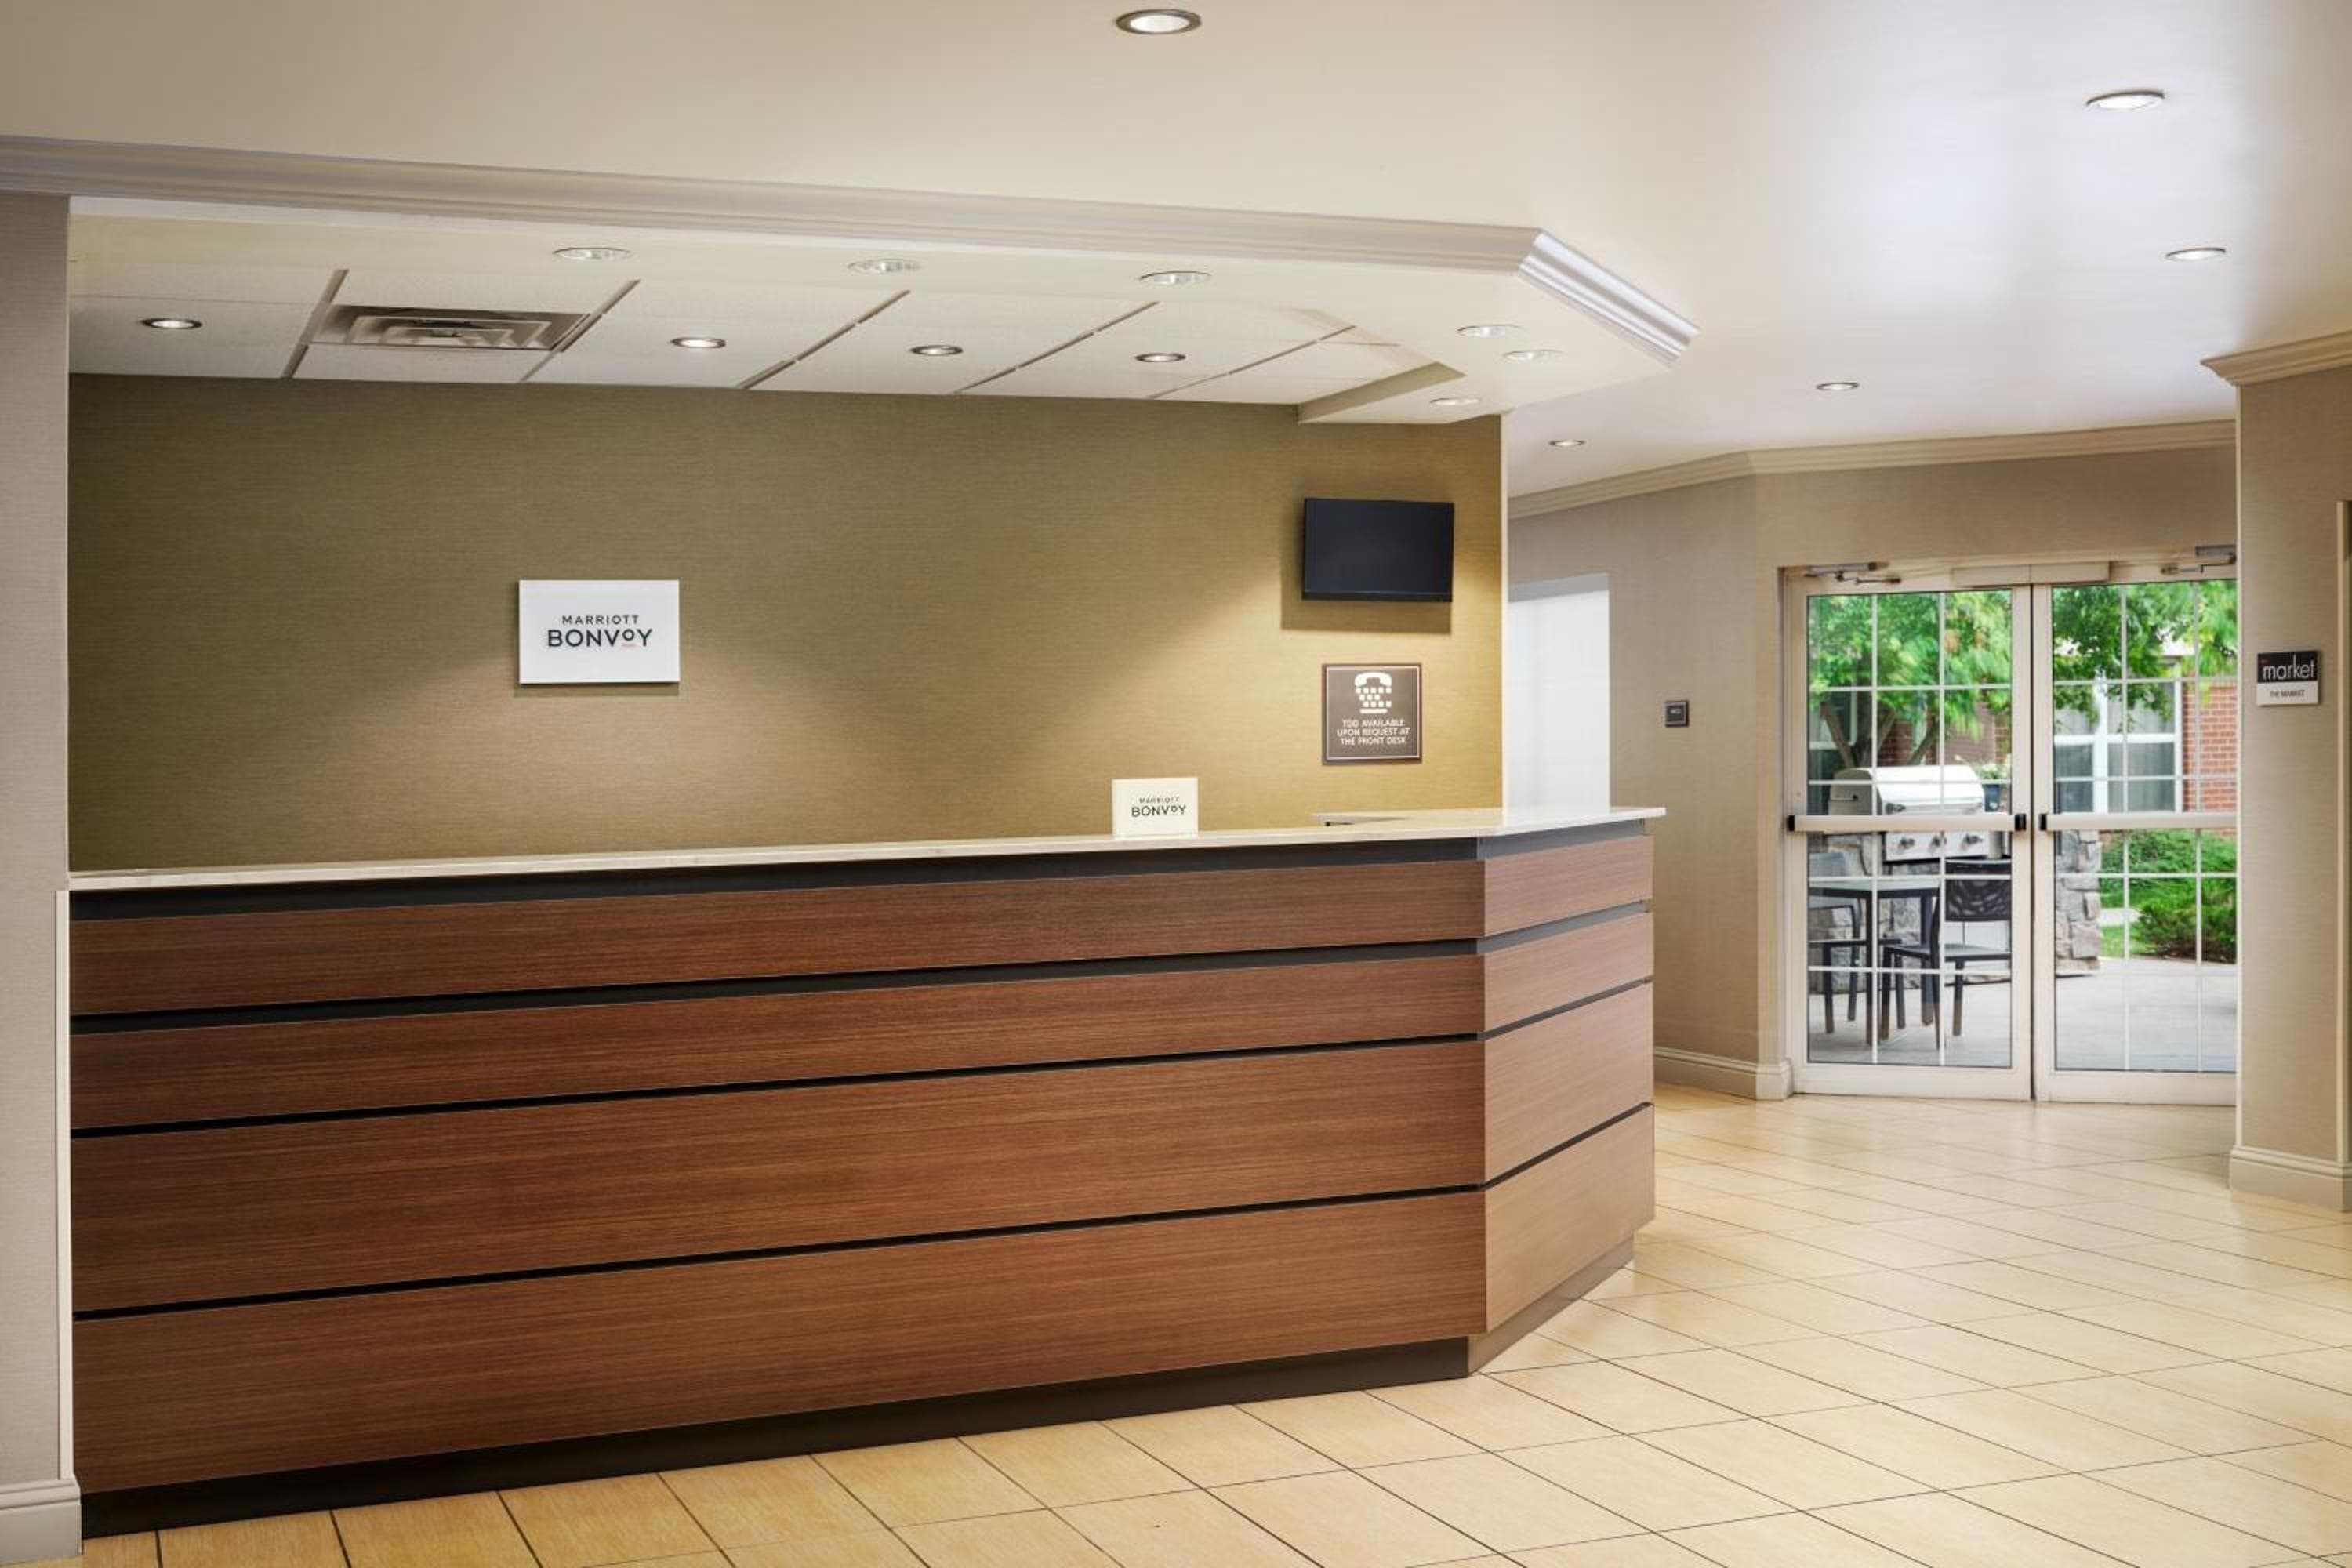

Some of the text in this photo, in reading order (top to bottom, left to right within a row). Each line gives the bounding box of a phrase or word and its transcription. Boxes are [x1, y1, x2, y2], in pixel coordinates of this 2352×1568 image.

[562, 615, 639, 625] MARRIOTT
[2263, 654, 2315, 681] market
[1337, 728, 1360, 737] UPON
[1363, 728, 1397, 736] REQUEST
